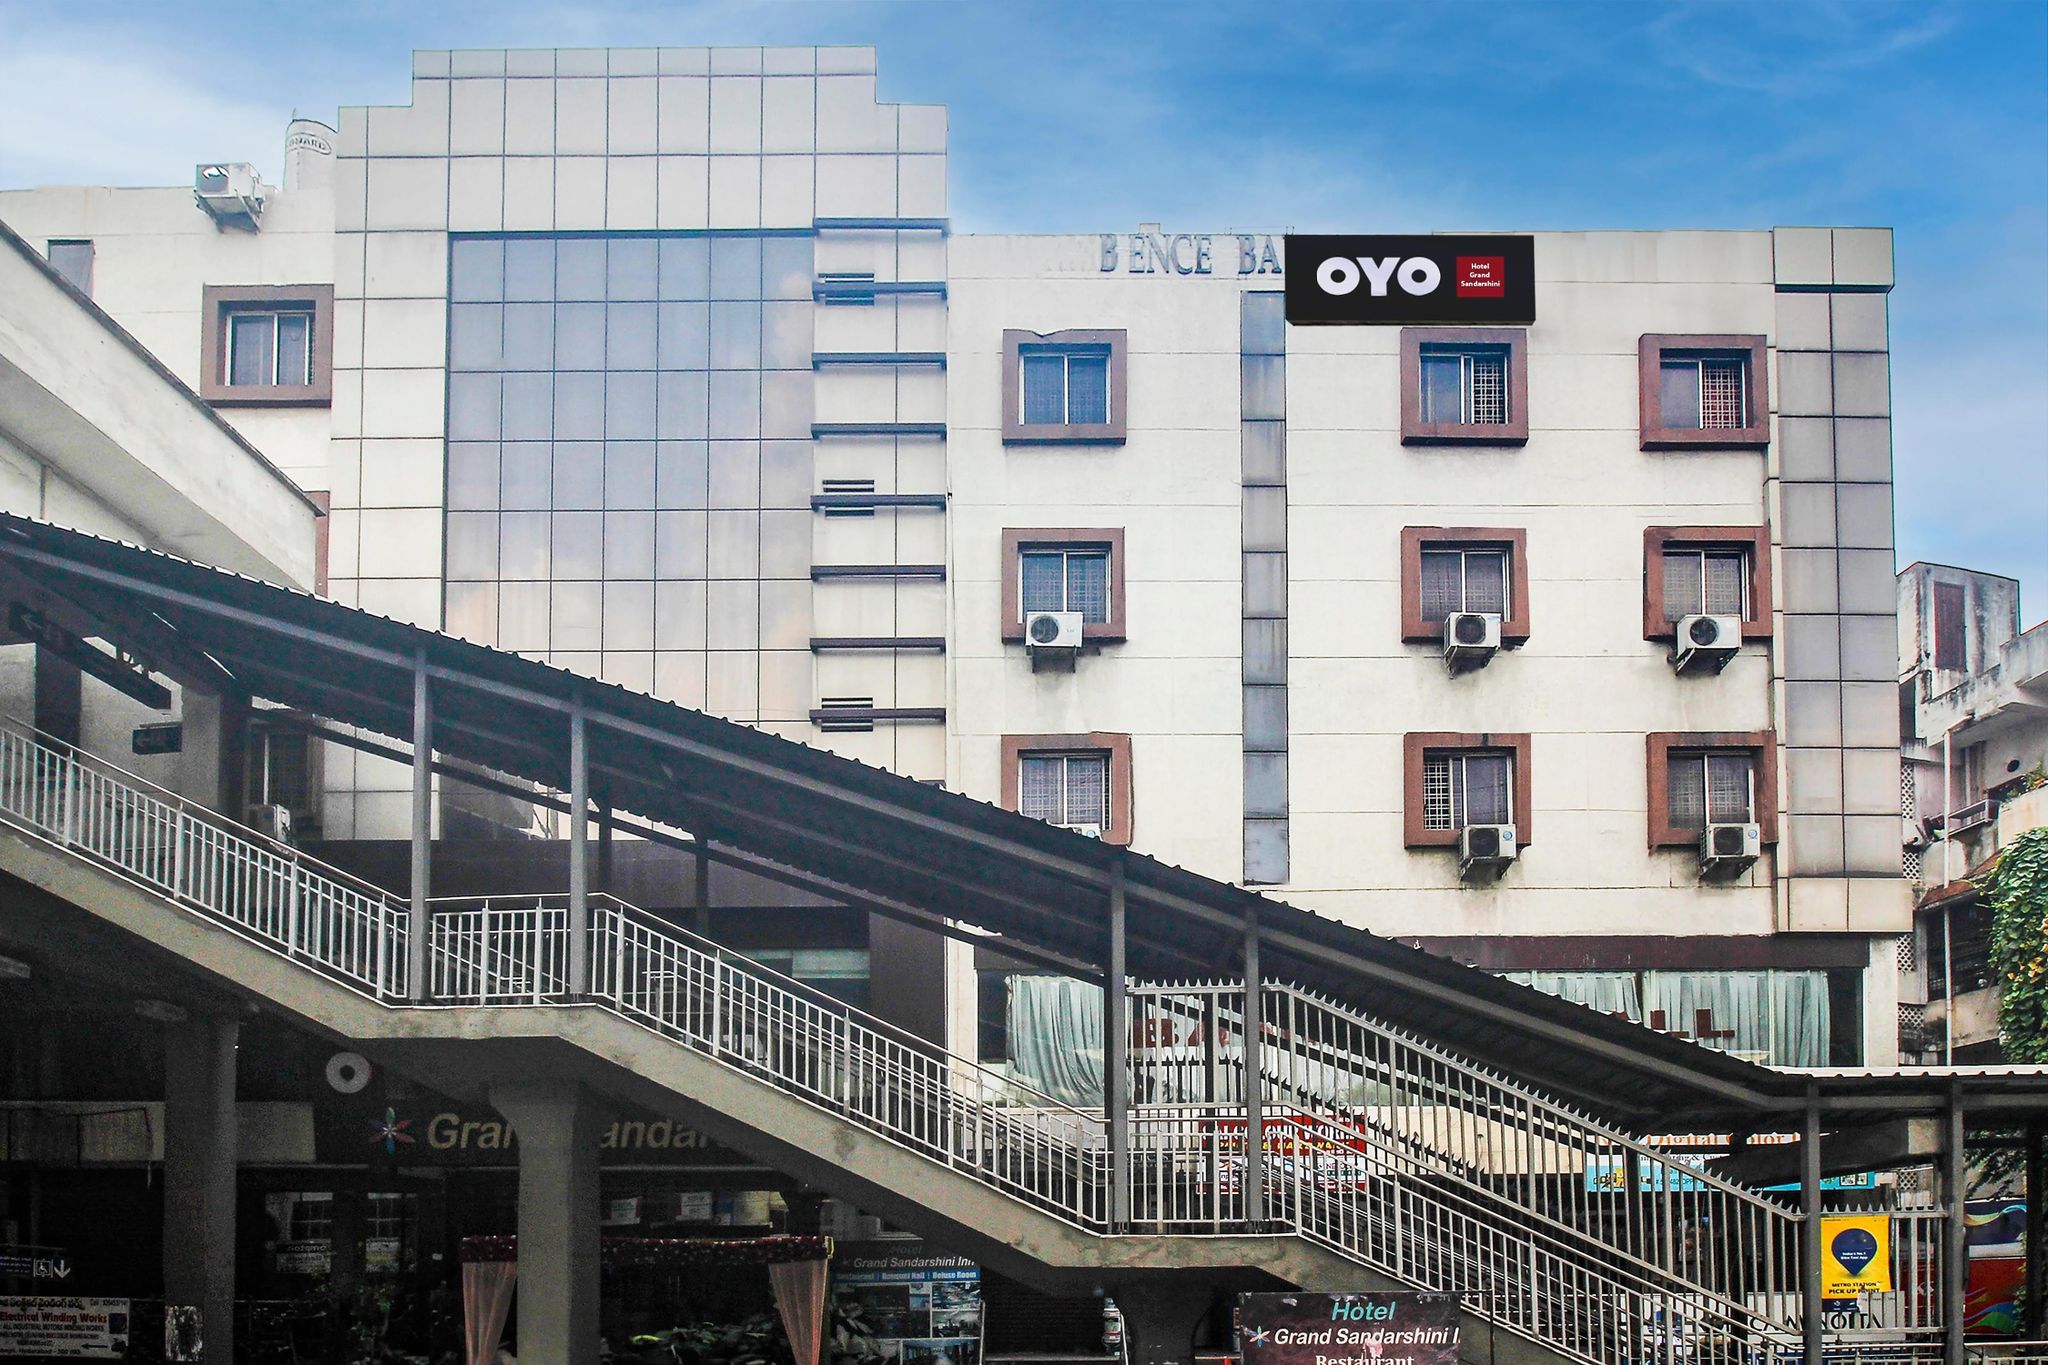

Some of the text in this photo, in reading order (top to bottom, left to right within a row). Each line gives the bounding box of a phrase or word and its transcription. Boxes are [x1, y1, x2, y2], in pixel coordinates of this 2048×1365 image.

[1316, 256, 1442, 297] OYO
[1460, 280, 1501, 288] Sandarshini
[853, 1257, 887, 1268] Grand
[890, 1257, 955, 1267] Sandarshini
[1331, 1301, 1396, 1321] Hotel
[41, 1312, 77, 1324] Winding
[80, 1313, 107, 1323] Works
[1274, 1328, 1332, 1345] Grand
[1335, 1328, 1450, 1345] Sandarshini
[1315, 1355, 1415, 1365] Restaurant
